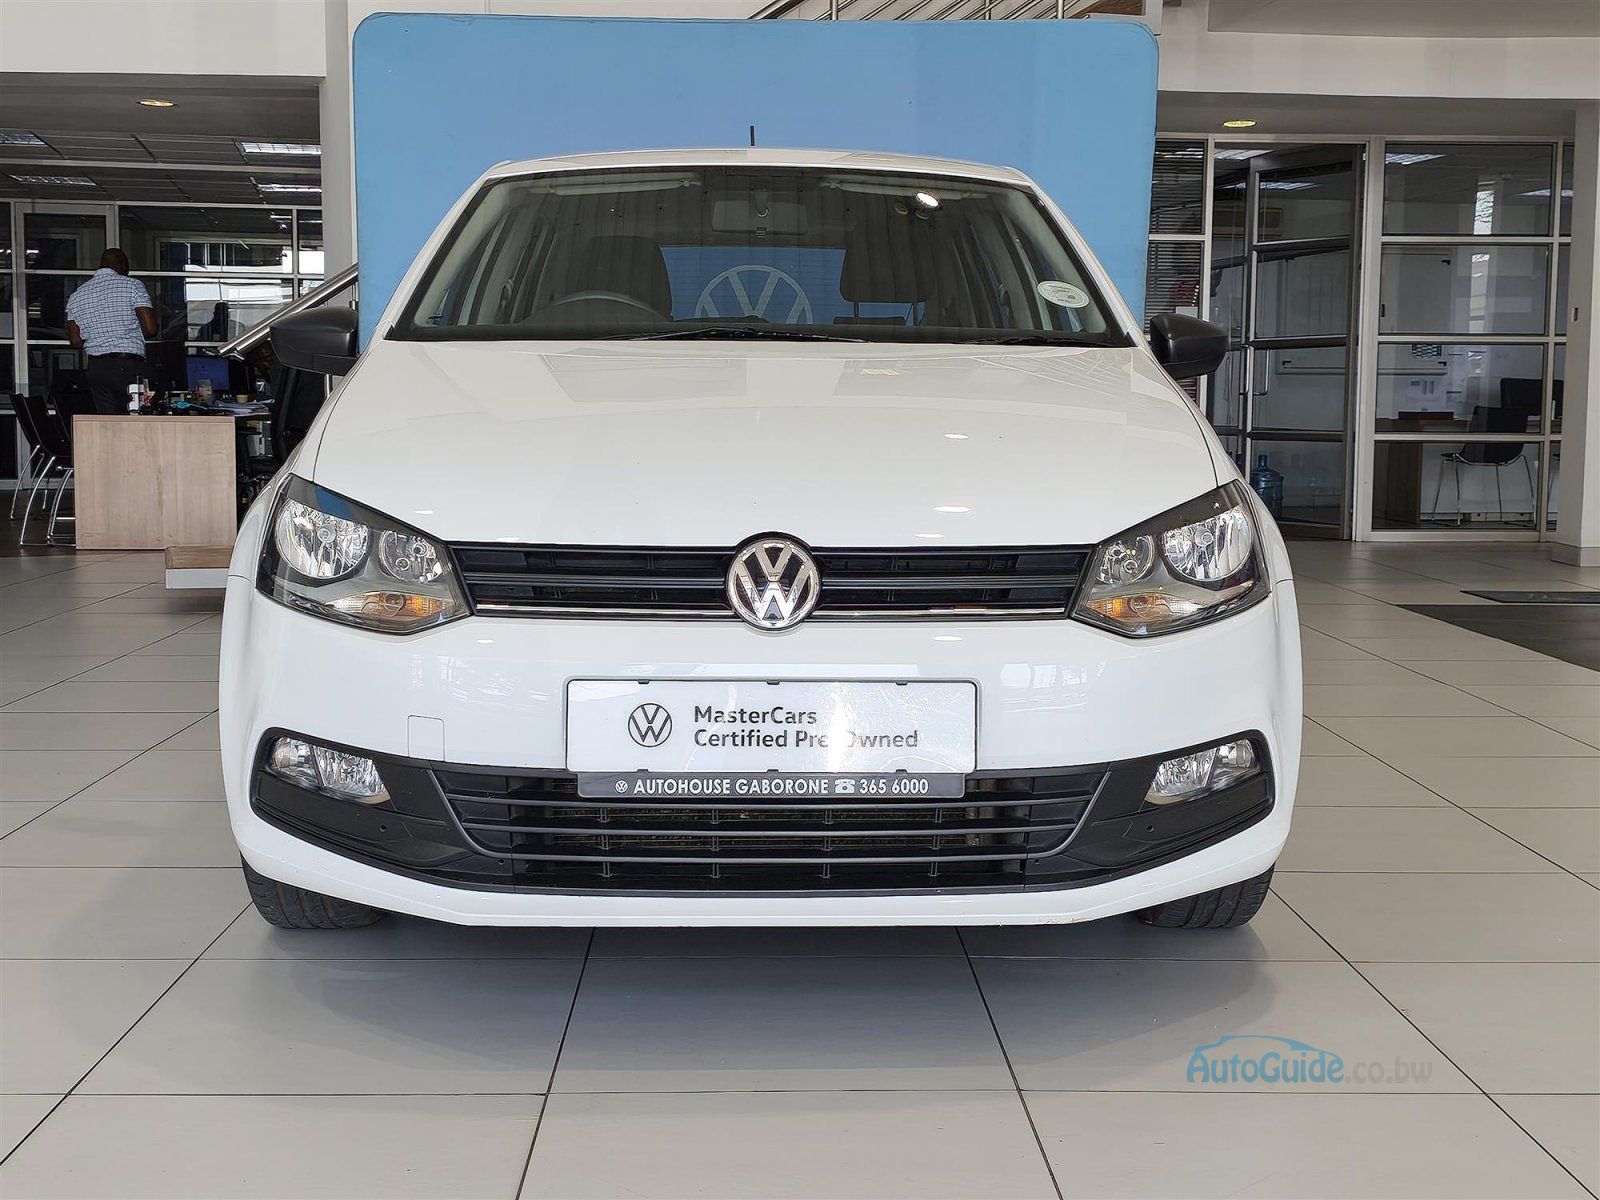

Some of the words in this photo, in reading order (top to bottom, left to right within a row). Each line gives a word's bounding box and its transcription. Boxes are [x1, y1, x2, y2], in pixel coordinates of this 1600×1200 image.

[694, 705, 817, 724] MasterCars
[694, 729, 787, 747] Certified
[634, 778, 731, 794] AUTOHOUSE
[735, 778, 829, 794] GABORONE
[859, 778, 887, 794] 365
[891, 778, 929, 794] 6000
